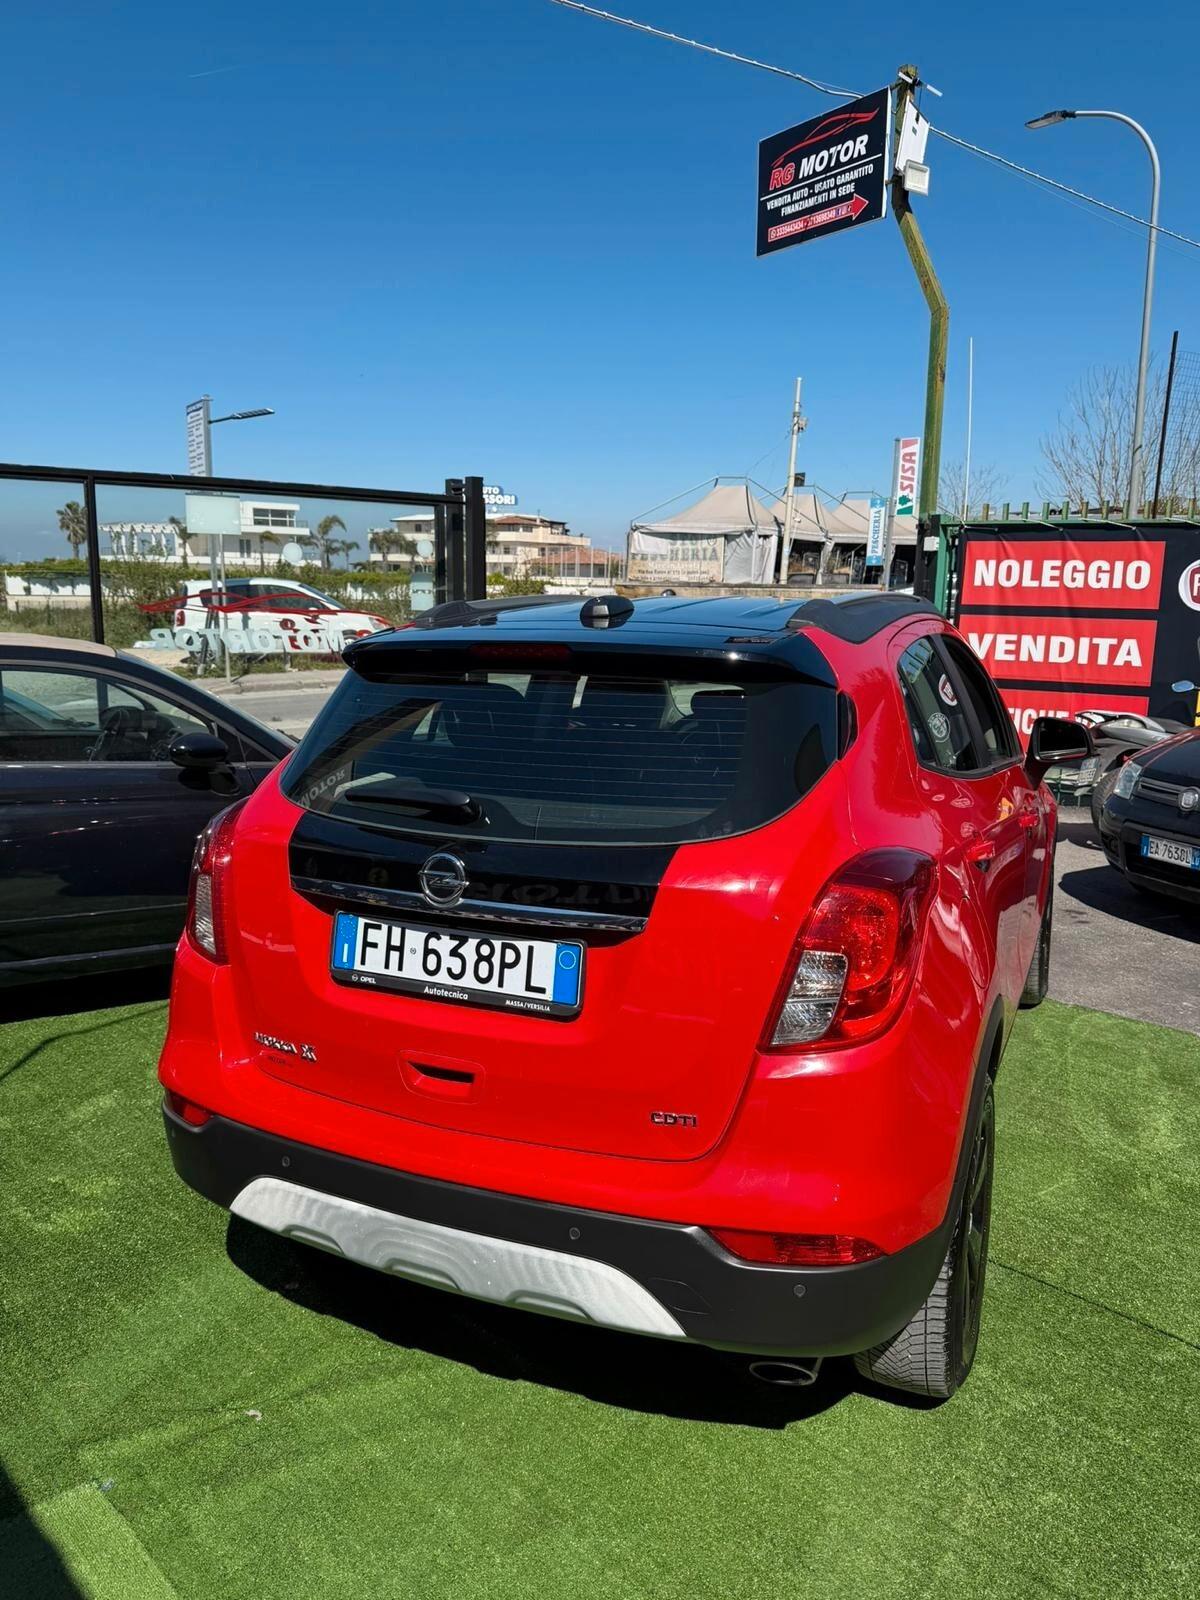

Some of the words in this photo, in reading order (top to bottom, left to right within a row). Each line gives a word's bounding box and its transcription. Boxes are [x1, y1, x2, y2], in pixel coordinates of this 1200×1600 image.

[769, 163, 795, 190] RG
[798, 134, 869, 179] MOTOR
[766, 194, 792, 210] VENDITA
[792, 187, 809, 201] AUTO
[814, 180, 835, 193] USATO
[836, 163, 874, 185] GARANTITO
[781, 193, 828, 217] FINANZIAMENTI
[829, 190, 837, 200] IN
[838, 182, 856, 197] SEDE
[899, 451, 918, 494] SISA
[482, 486, 499, 494] UTO
[973, 559, 1150, 591] NOLEGGIO
[968, 632, 1142, 667] VENDITA
[1149, 840, 1160, 856] EA
[360, 922, 406, 972] FH
[422, 931, 546, 995] 638PL
[360, 975, 376, 984] OPEL
[423, 985, 468, 1000] Autotecnica
[505, 1000, 550, 1011] MASSA/VERSILIA
[650, 1111, 697, 1127] CDTI
